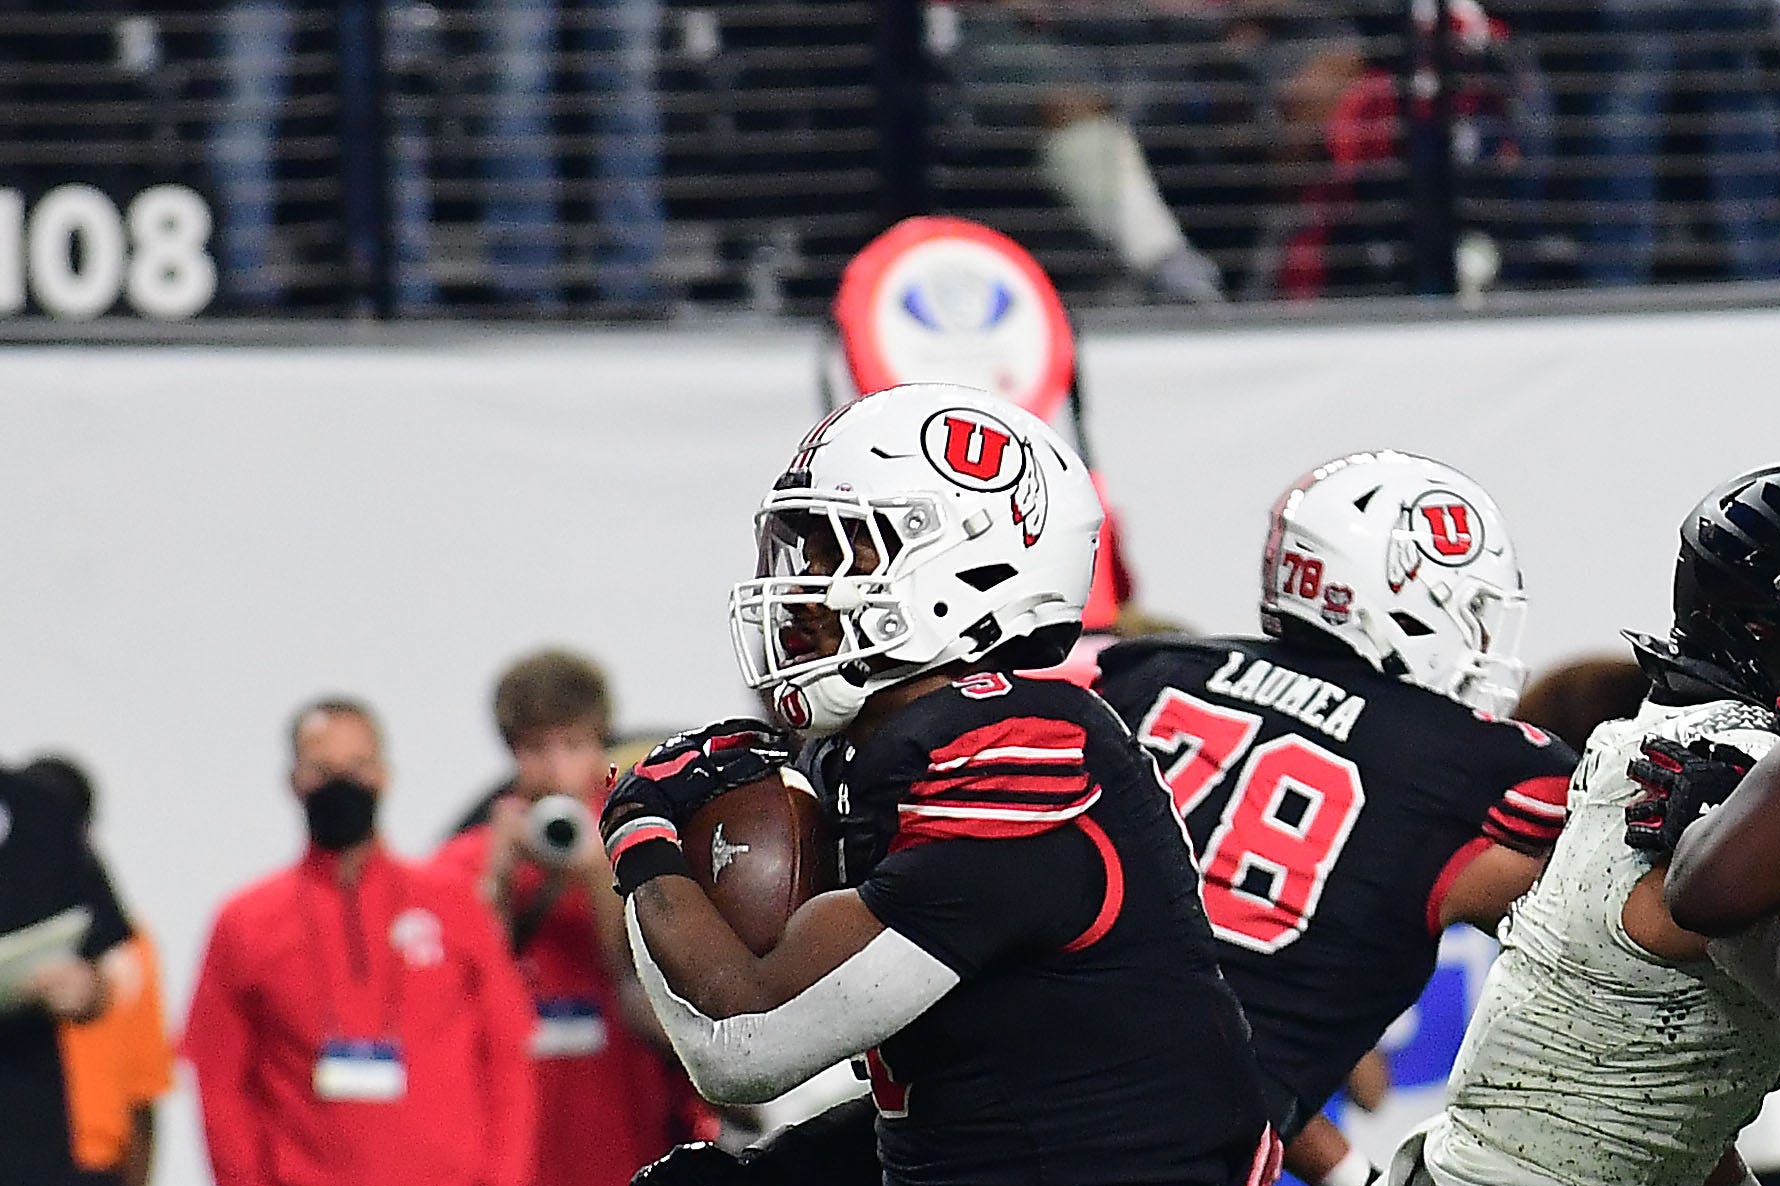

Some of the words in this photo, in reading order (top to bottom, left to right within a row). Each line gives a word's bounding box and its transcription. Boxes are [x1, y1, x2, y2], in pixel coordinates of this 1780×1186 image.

[943, 416, 1011, 482] U
[1420, 504, 1472, 556] U
[1283, 552, 1325, 600] 78
[1205, 650, 1367, 742] LAUMEA
[1136, 686, 1366, 954] 78
